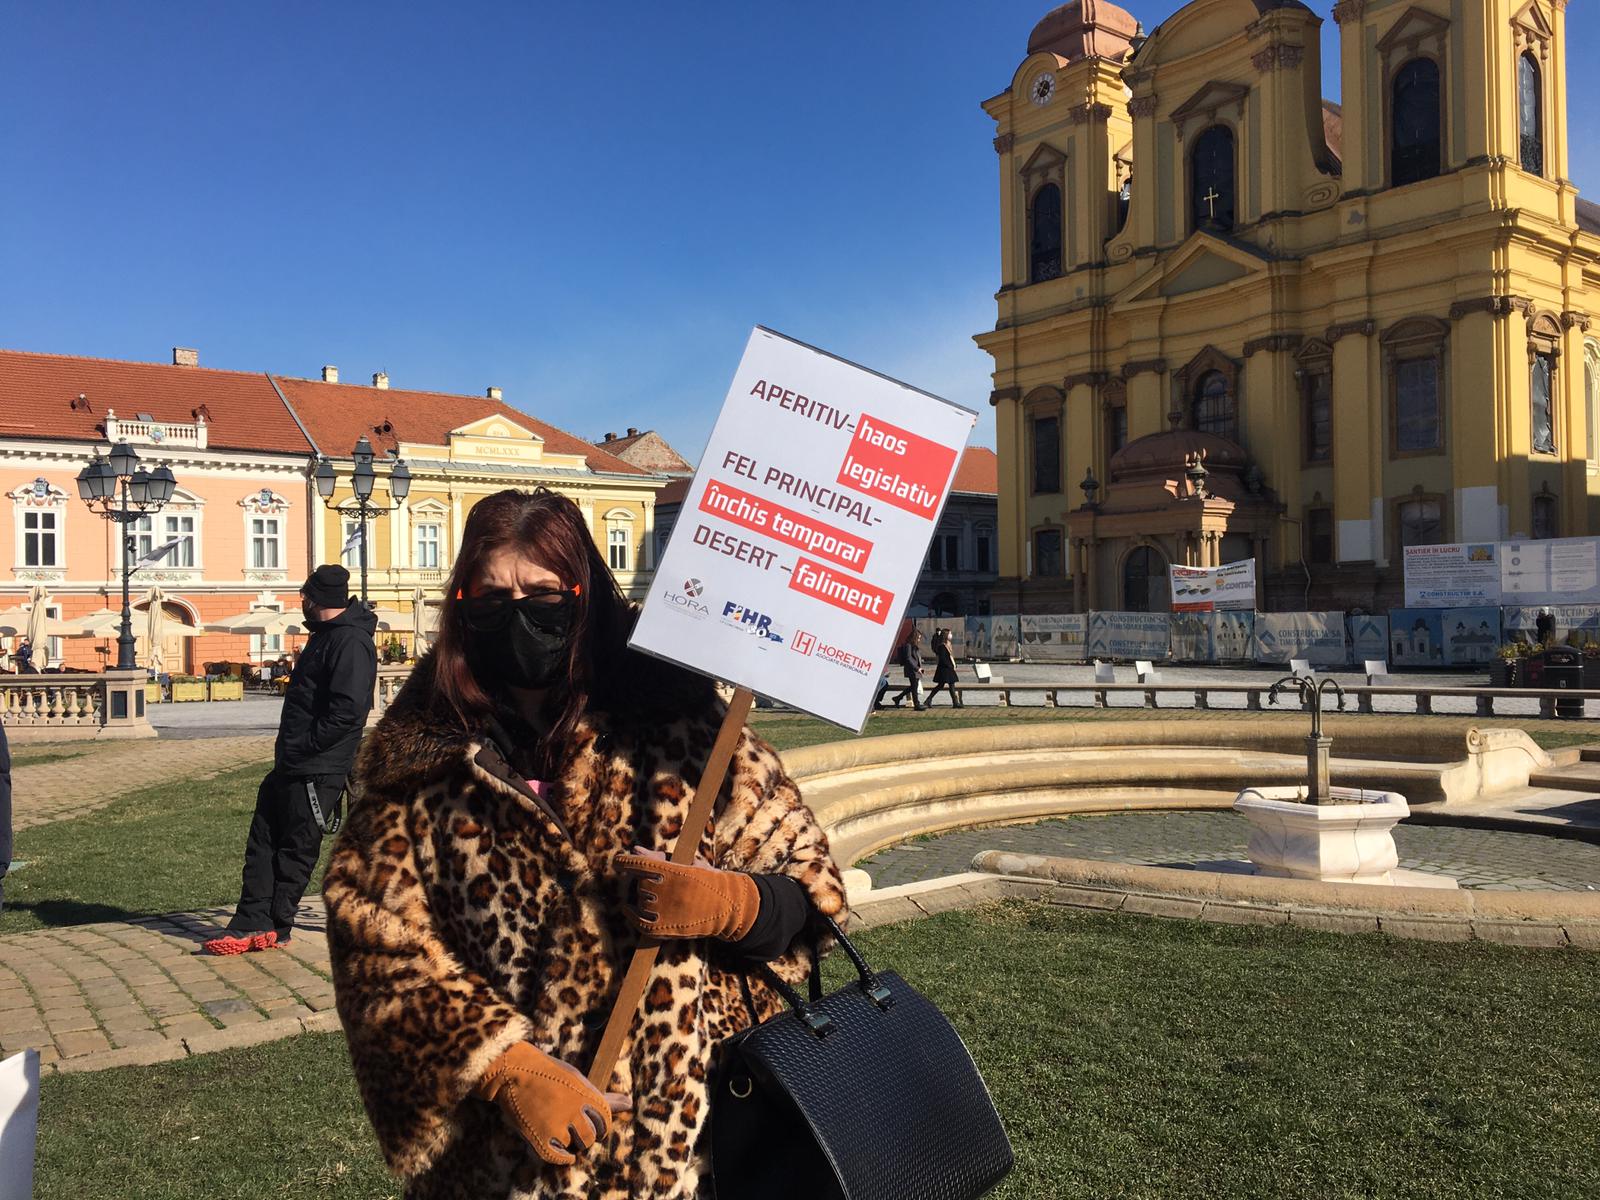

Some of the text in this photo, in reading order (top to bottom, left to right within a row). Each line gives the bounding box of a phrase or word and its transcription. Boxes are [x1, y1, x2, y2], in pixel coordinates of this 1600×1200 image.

[859, 420, 908, 455] haos
[722, 451, 758, 481] FEL
[843, 456, 937, 508] legislativ
[707, 486, 865, 564] închis temporar
[693, 524, 778, 570] DESERT
[796, 565, 882, 614] faliment
[664, 591, 709, 615] HORA
[817, 643, 872, 671] HORETIM
